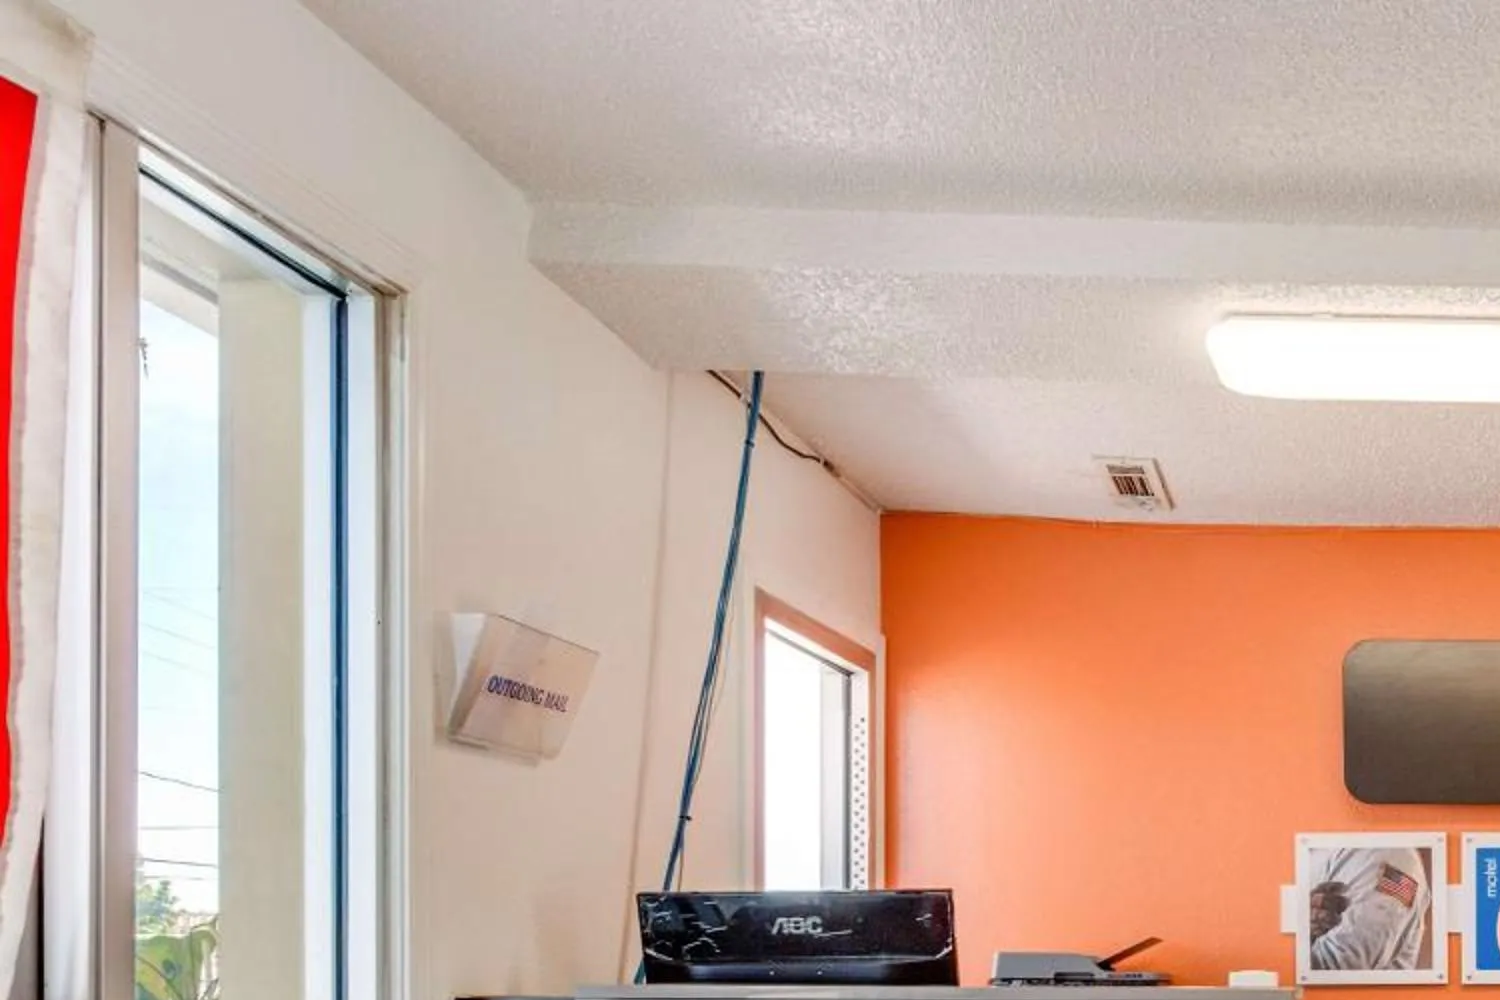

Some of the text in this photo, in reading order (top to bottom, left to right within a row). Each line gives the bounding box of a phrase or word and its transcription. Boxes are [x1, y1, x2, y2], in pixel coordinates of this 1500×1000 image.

[487, 675, 569, 713] OUTGOING MAIL
[1483, 858, 1497, 898] motel
